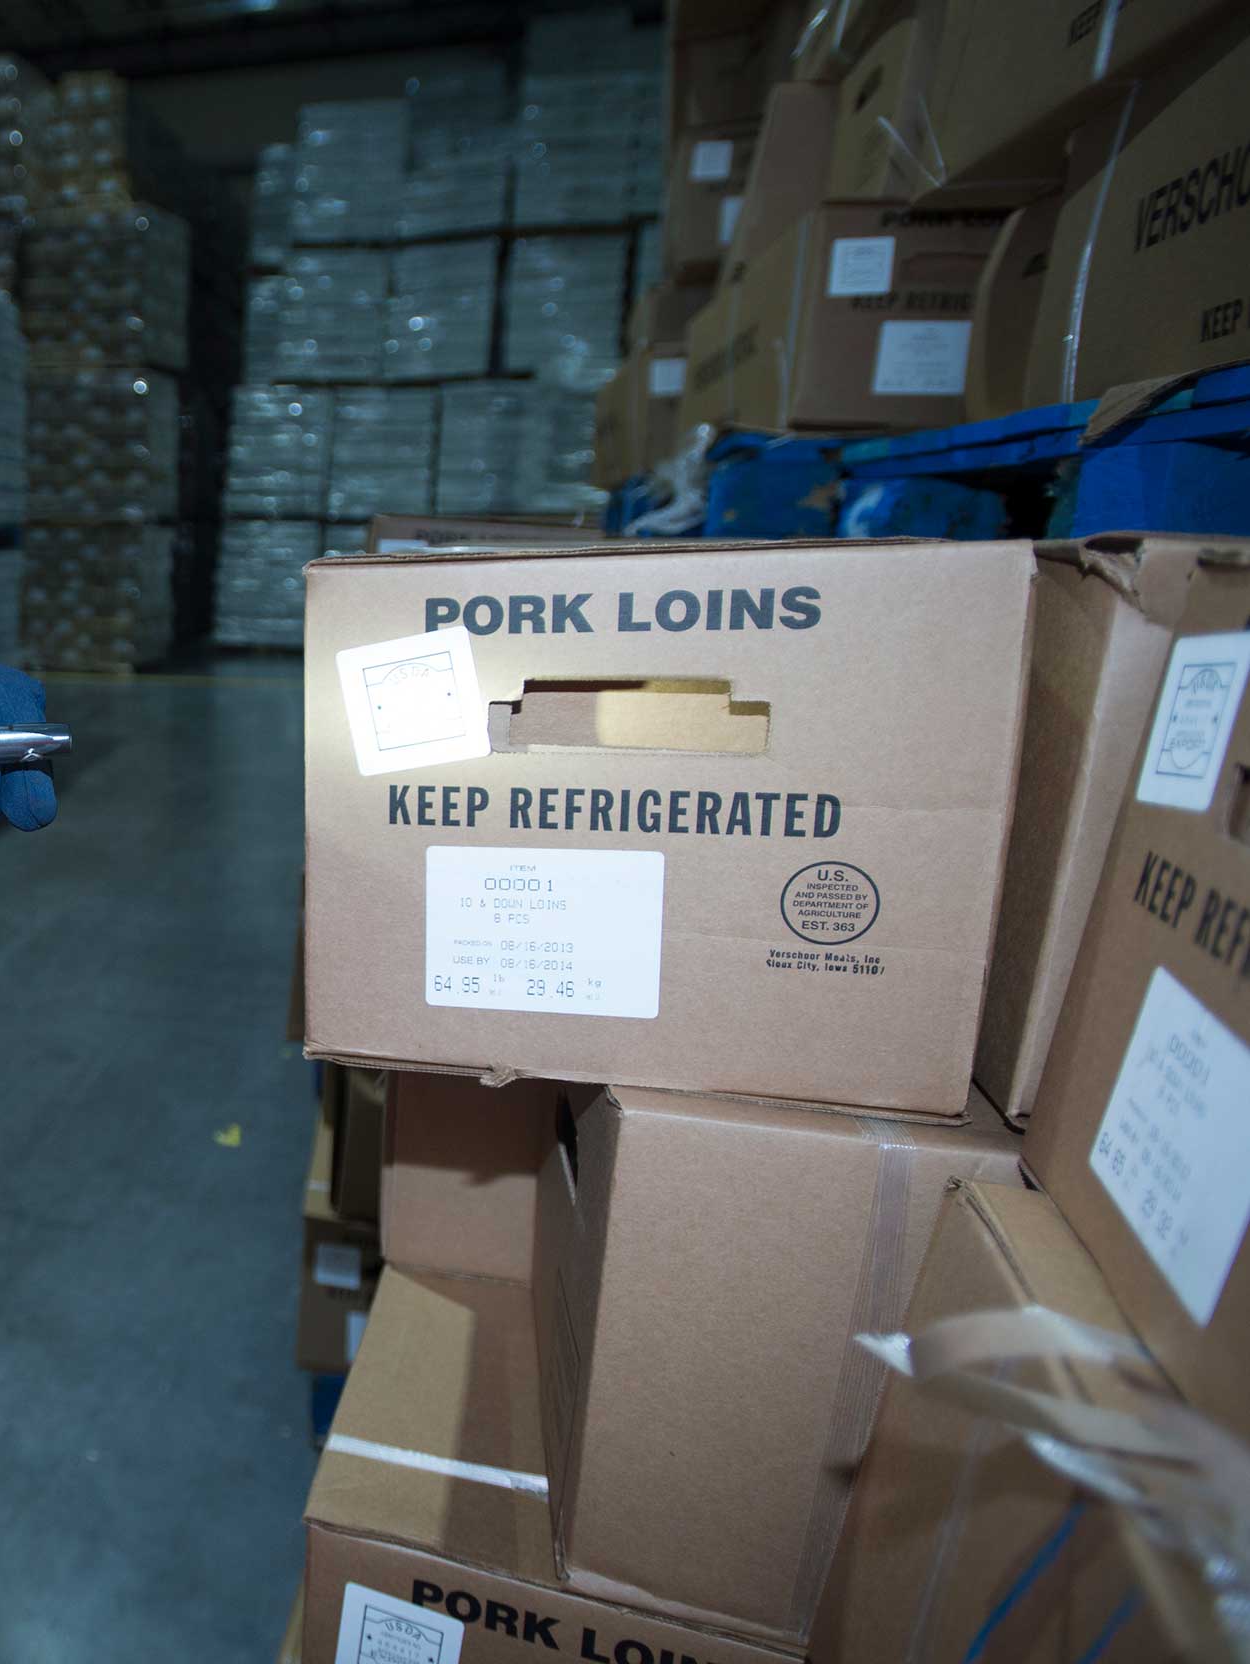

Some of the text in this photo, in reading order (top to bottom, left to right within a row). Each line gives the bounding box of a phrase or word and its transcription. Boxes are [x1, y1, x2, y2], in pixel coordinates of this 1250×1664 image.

[1200, 298, 1243, 343] KEEP
[424, 585, 822, 636] PORK LOINS
[388, 784, 842, 839] KEEP REFRIGERATED
[817, 869, 849, 882] U.S.
[484, 877, 554, 892] 00001
[806, 882, 859, 892] INSPECTED
[1134, 849, 1197, 929] KEEP
[795, 891, 868, 901] AND PASSED BY
[493, 898, 523, 909] DOWN
[529, 899, 567, 911] LOINS
[792, 900, 854, 909] DEPARTMENT
[797, 909, 862, 919] AGRICULTURE
[801, 920, 855, 932] EST. 363
[500, 940, 574, 954] 08/16/2013
[452, 955, 490, 966] USE BY
[769, 949, 821, 960] Verschoor
[500, 957, 573, 971] 08/16/2014
[410, 1578, 561, 1650] PORK
[384, 1621, 422, 1641] USDA
